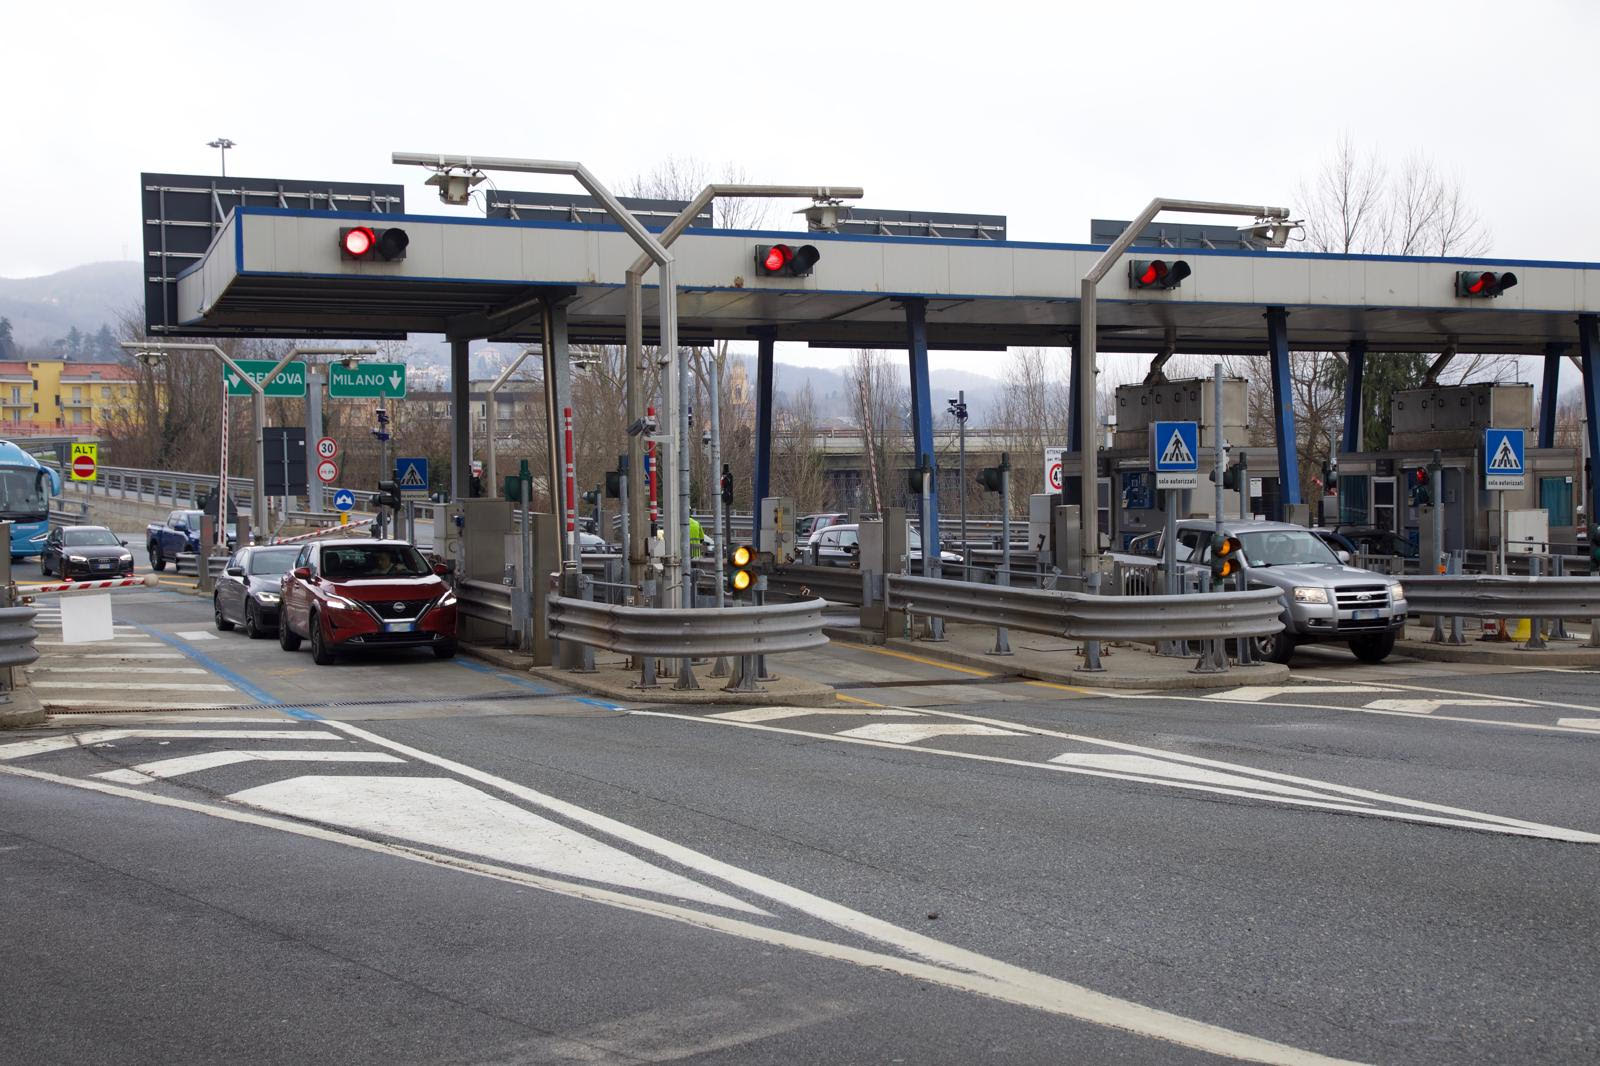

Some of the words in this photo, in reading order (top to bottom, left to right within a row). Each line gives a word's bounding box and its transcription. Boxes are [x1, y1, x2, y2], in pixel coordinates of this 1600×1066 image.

[333, 374, 385, 386] MILANO
[74, 446, 95, 454] ALT
[321, 443, 333, 453] 30
